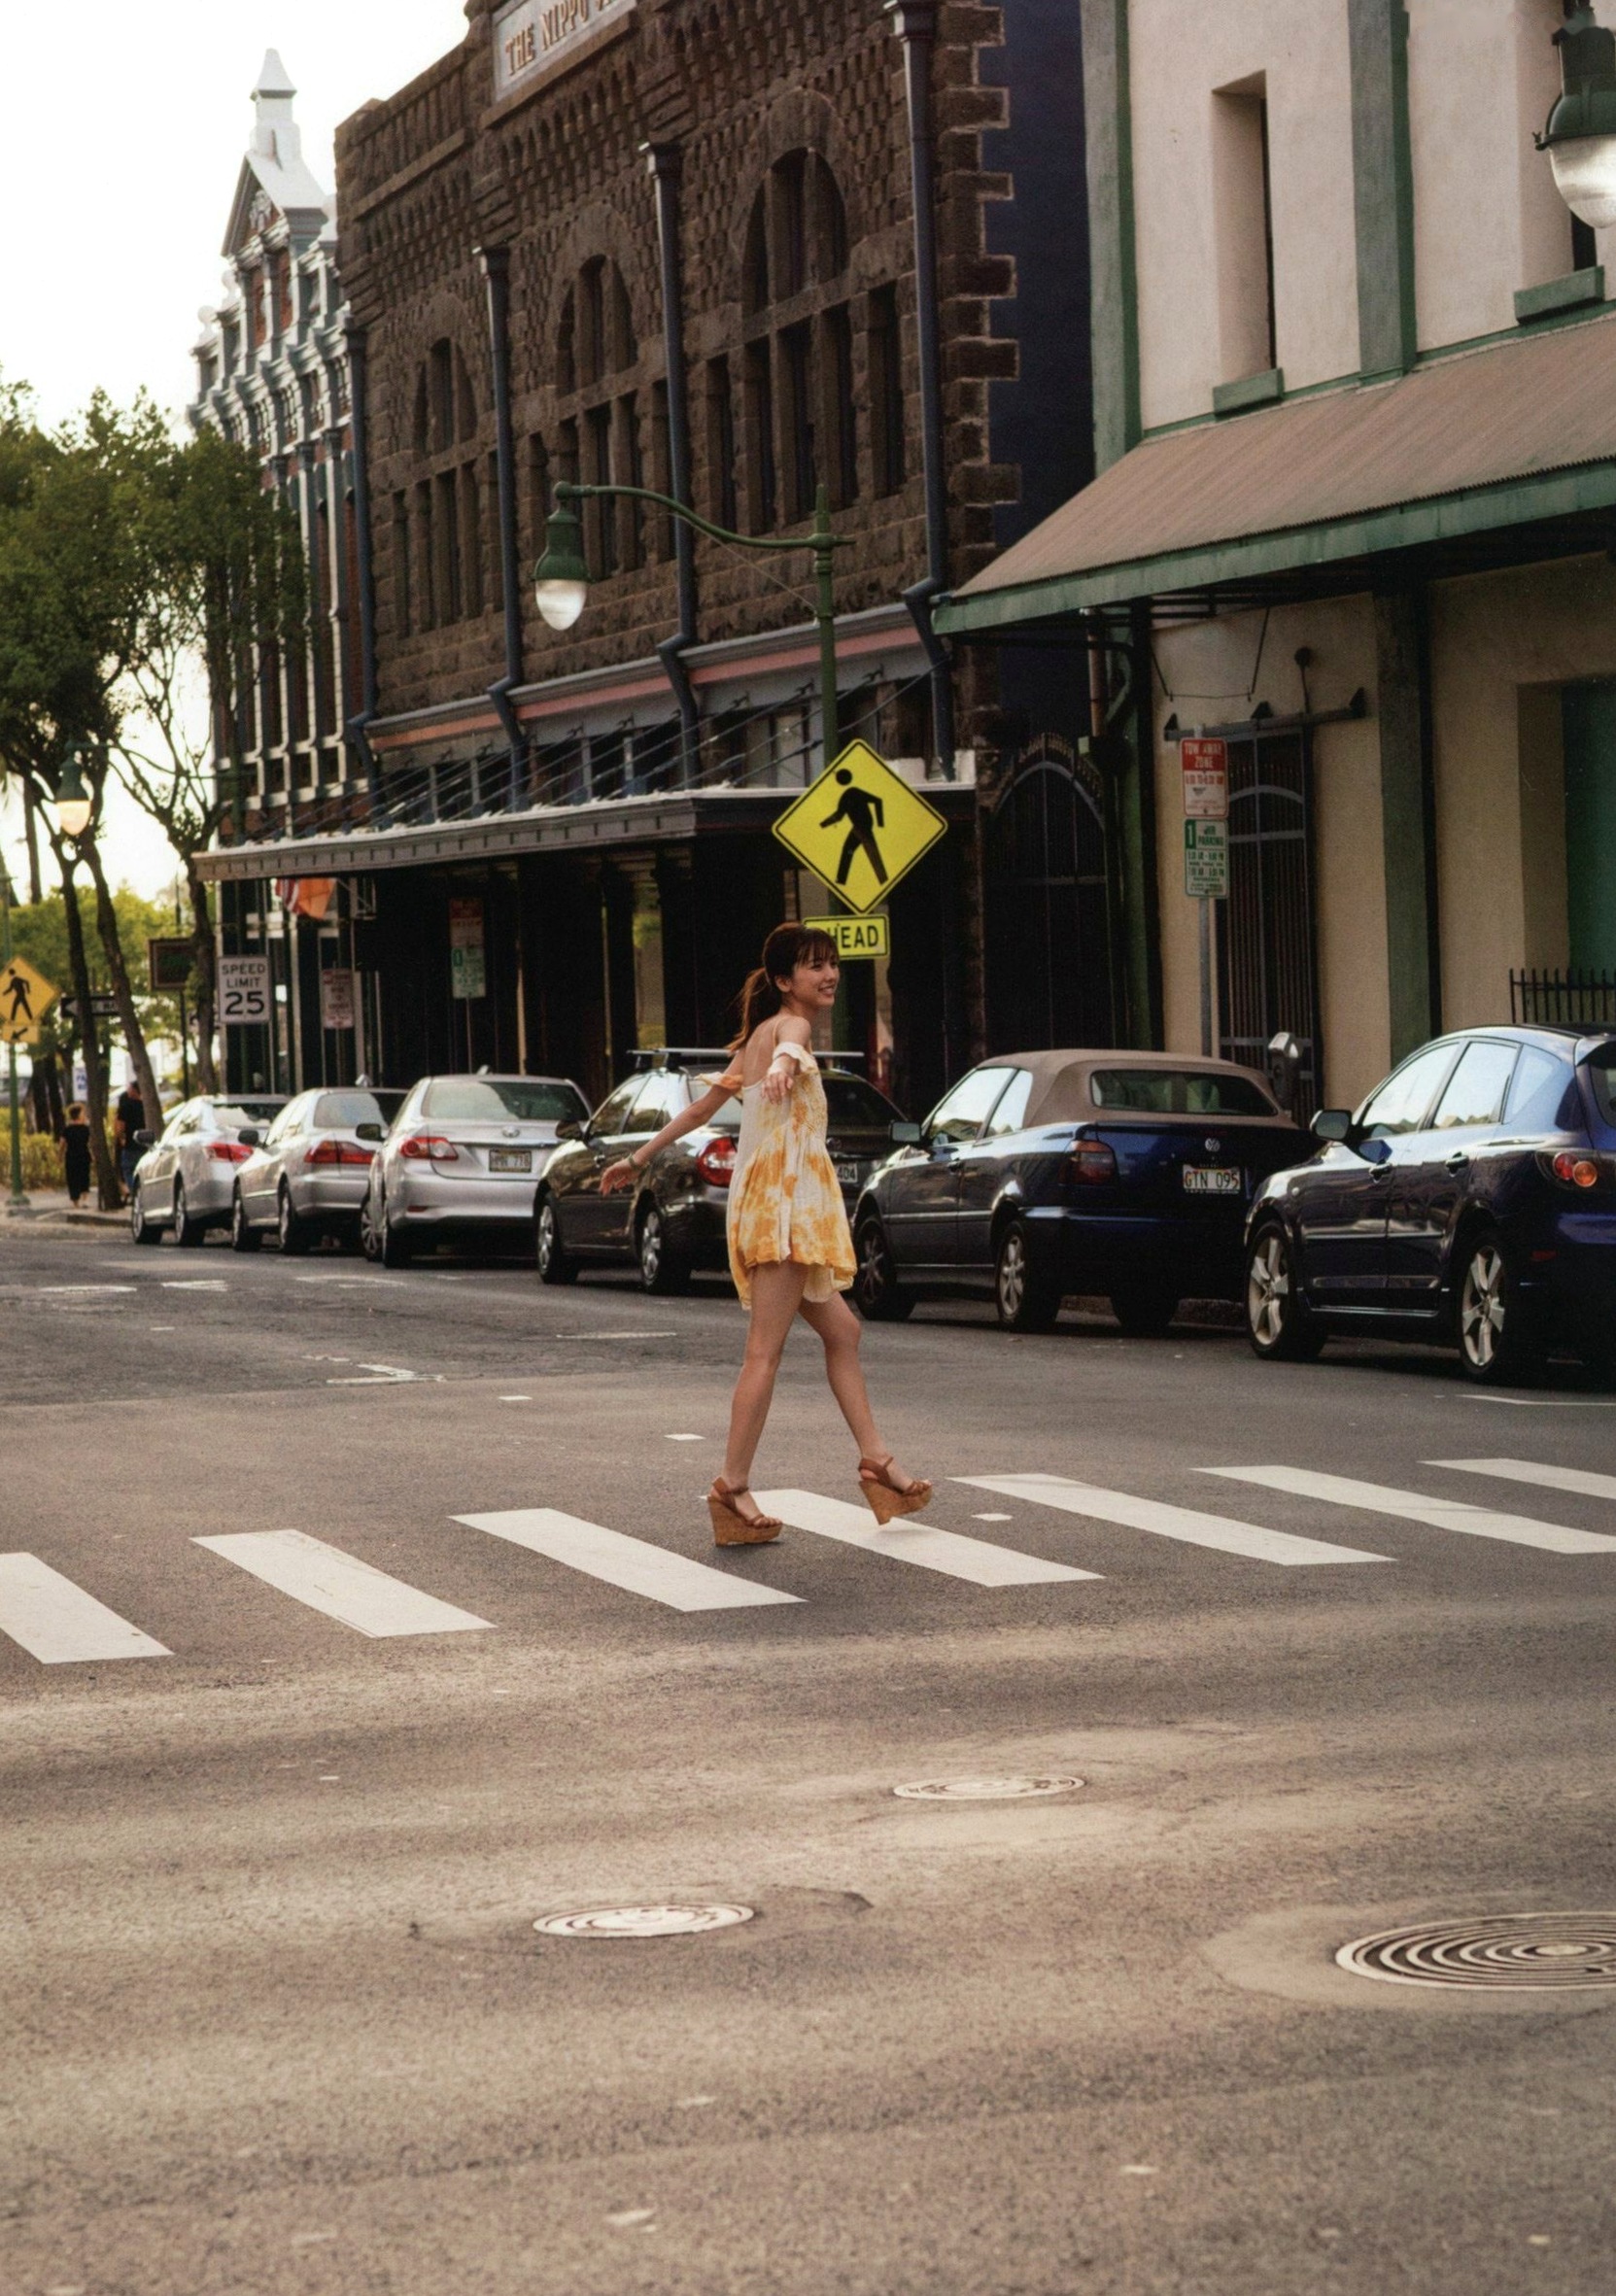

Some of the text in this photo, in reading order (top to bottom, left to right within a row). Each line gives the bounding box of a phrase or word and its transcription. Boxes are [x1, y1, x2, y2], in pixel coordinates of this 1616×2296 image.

[505, 23, 536, 77] THE
[1185, 742, 1222, 756] TOW AWAY
[1194, 755, 1214, 769] ZONE
[1186, 824, 1194, 846] 1
[827, 925, 879, 949] HEAD
[222, 963, 265, 976] SPEED
[226, 977, 260, 989] LIMIT
[224, 991, 265, 1015] 25
[1185, 1170, 1240, 1189] GTN 095
